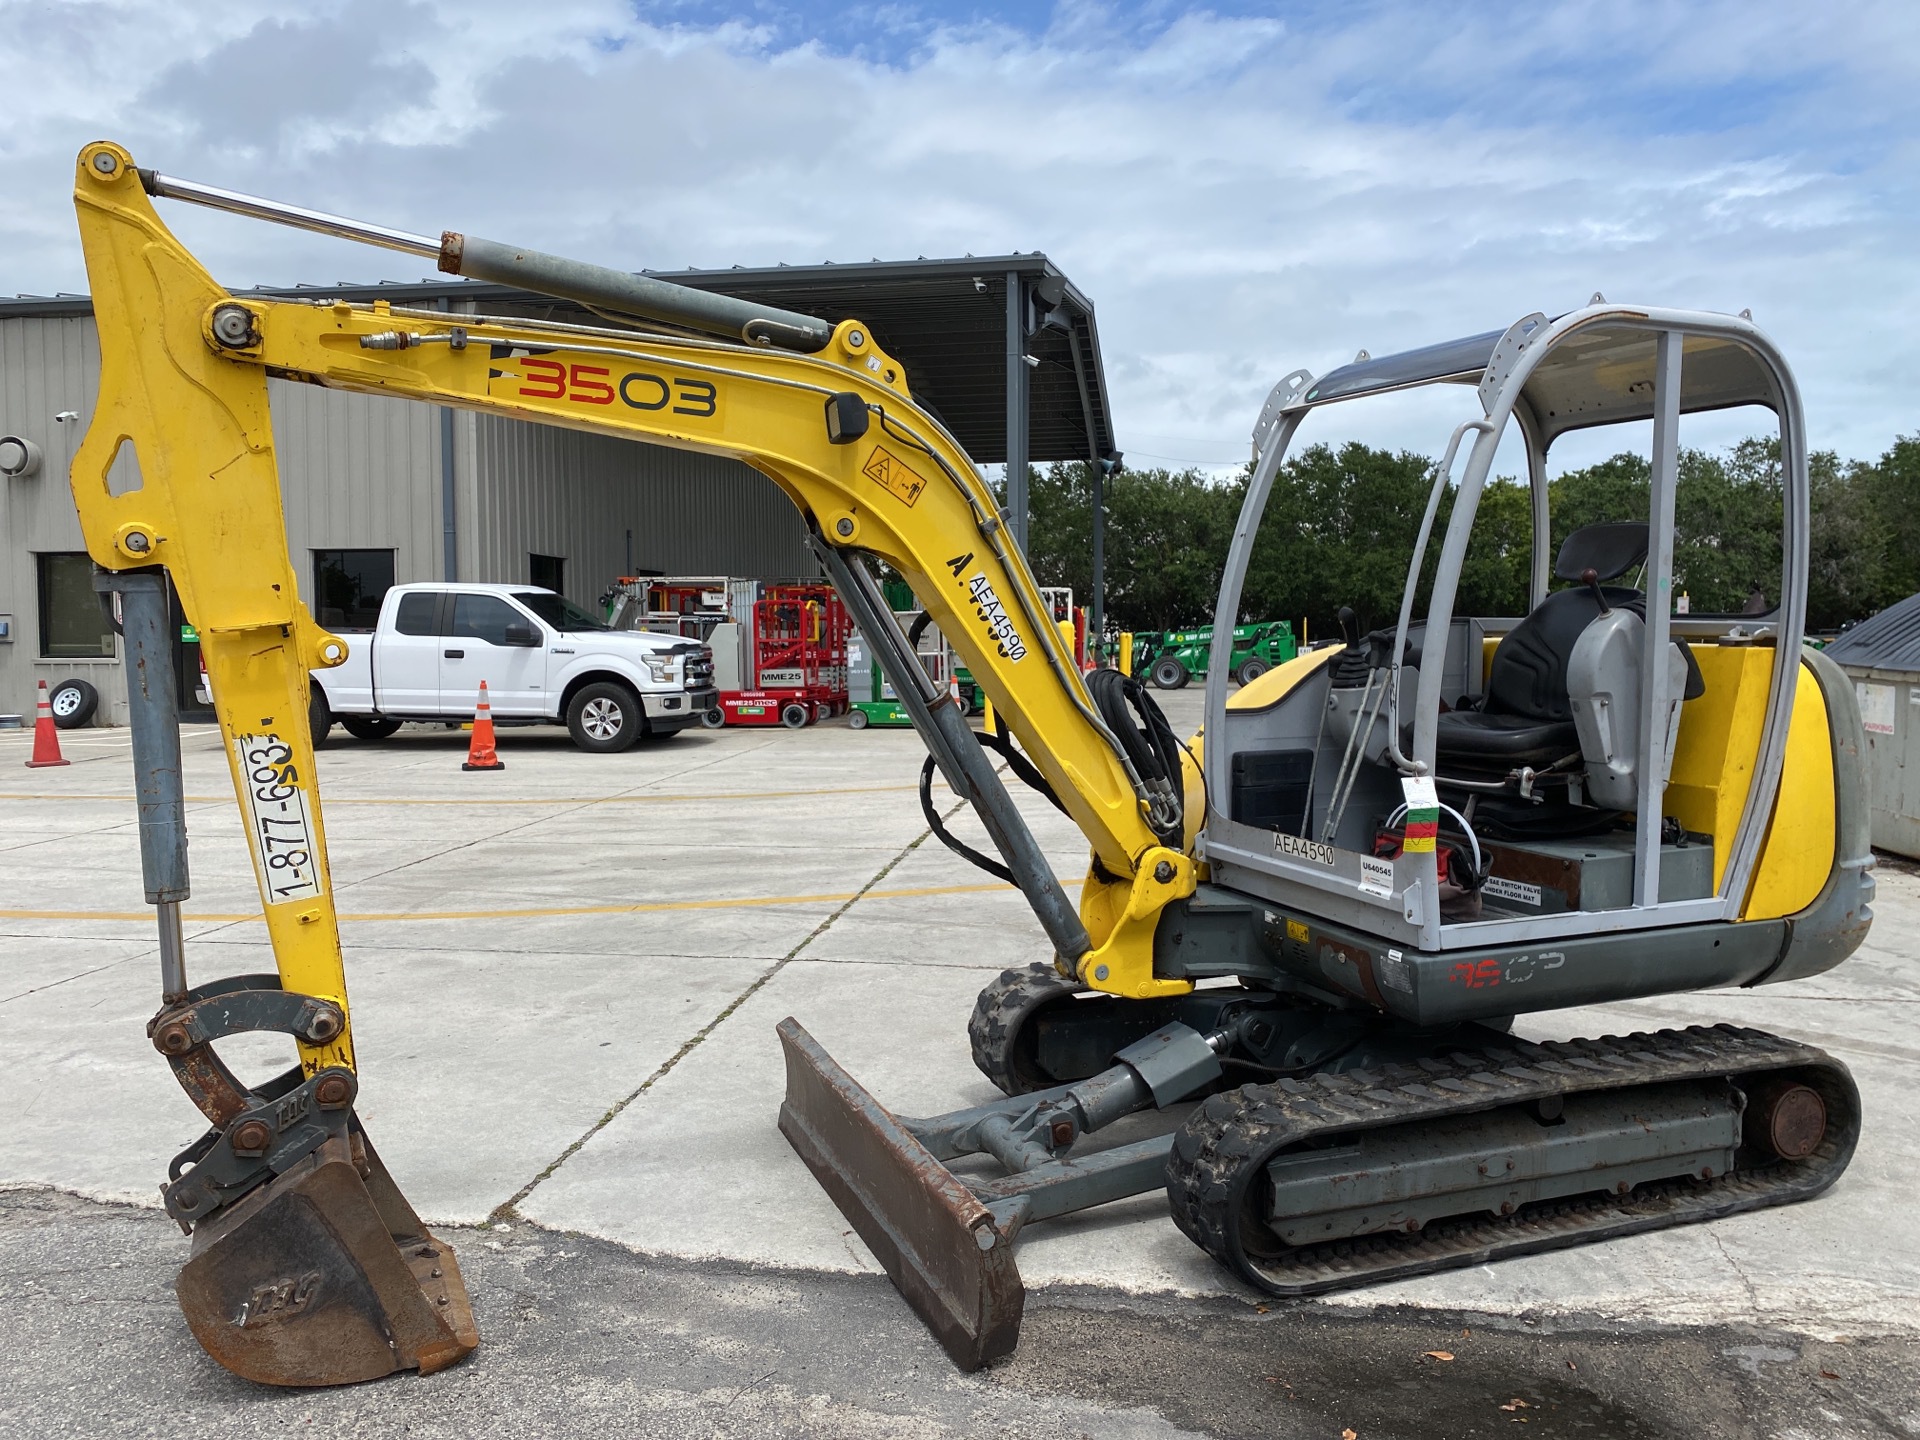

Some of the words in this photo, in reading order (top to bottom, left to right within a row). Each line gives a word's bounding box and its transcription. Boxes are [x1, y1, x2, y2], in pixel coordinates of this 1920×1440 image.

[519, 357, 717, 417] 3503
[969, 576, 1027, 661] AEA4590
[761, 672, 802, 681] MME25
[1274, 833, 1335, 865] AEA4590
[1362, 861, 1393, 877] U640545
[1484, 886, 1503, 894] UNDER
[1503, 889, 1522, 899] FLOOR
[1522, 894, 1535, 902] MAT
[1489, 878, 1500, 886] SAE
[1501, 881, 1522, 890] SWITCH
[1523, 885, 1541, 895] VALVE
